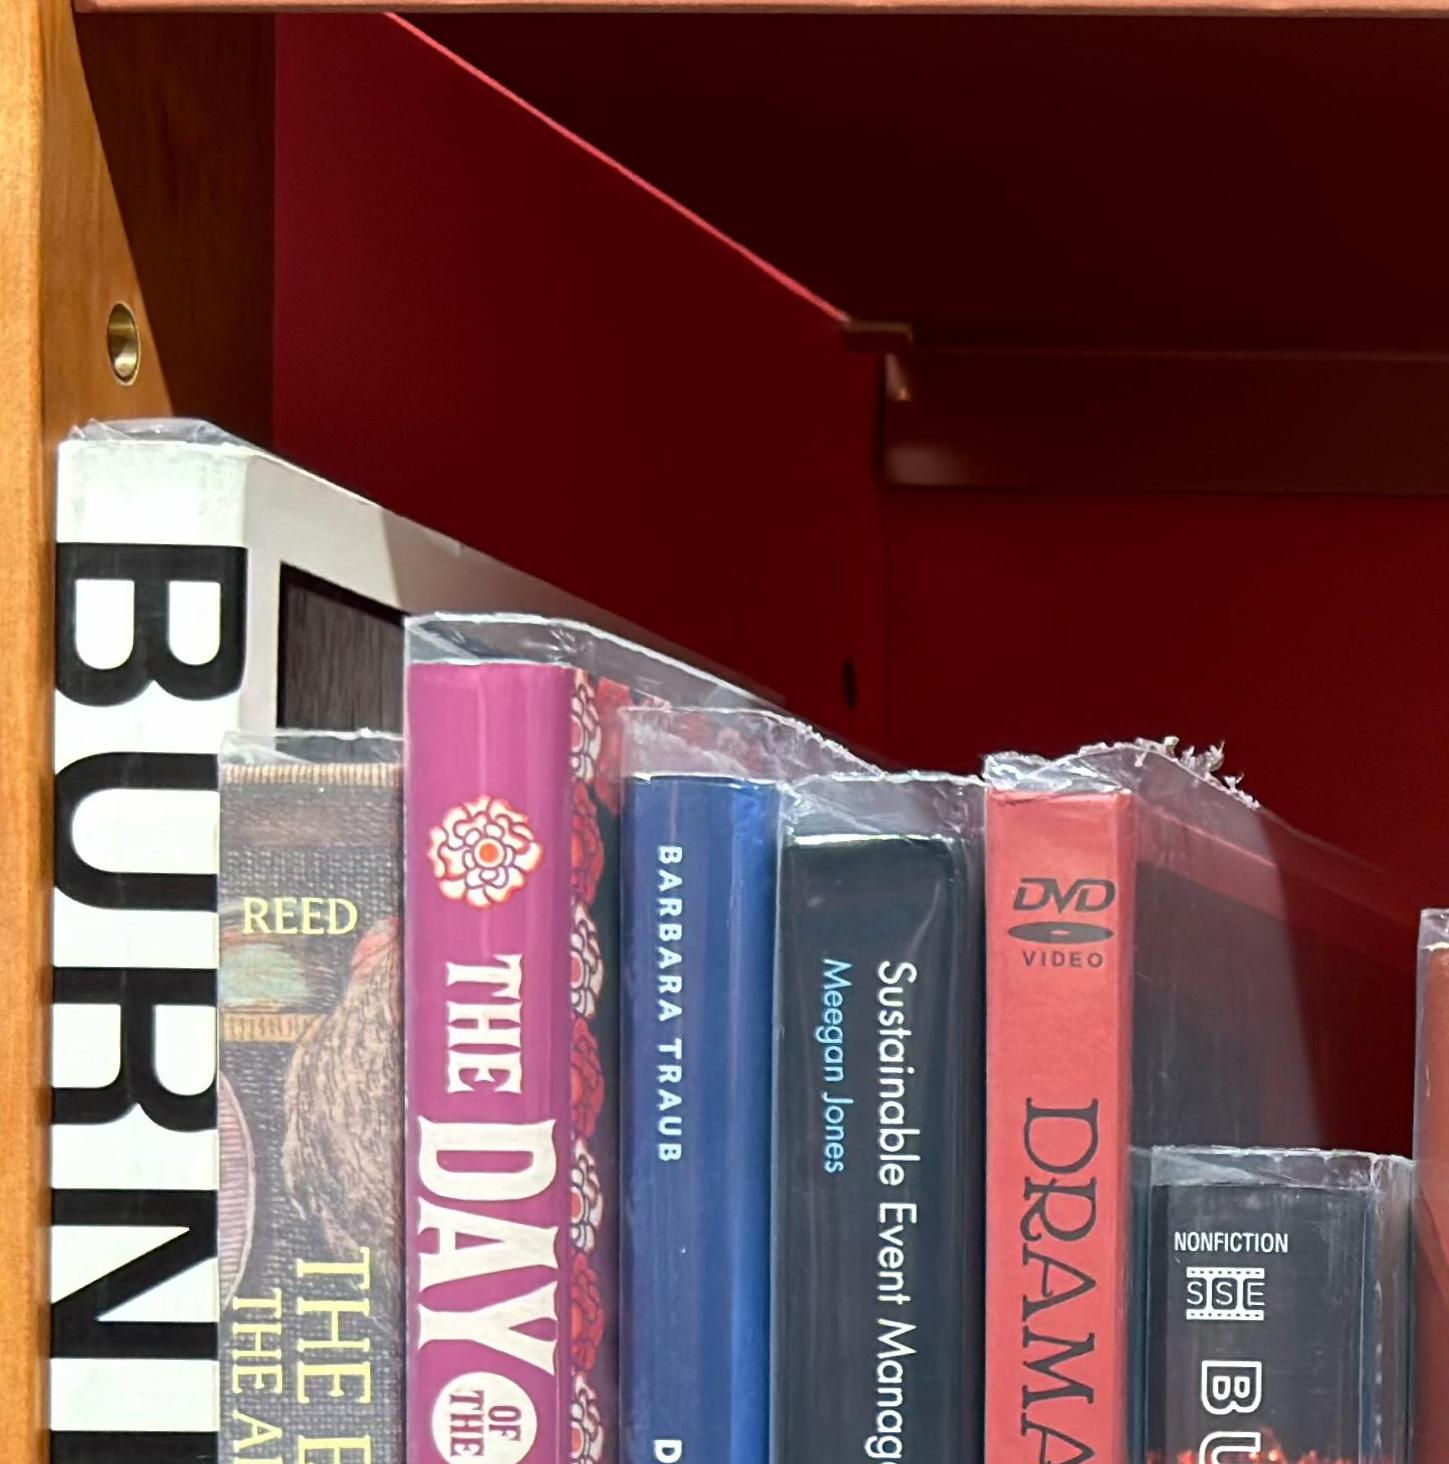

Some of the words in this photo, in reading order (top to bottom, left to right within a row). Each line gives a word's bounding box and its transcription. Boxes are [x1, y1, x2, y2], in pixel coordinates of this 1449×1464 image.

[242, 897, 358, 934] REED
[657, 846, 683, 1022] BARBARA
[1013, 878, 1116, 914] DVD
[1022, 950, 1104, 968] VIDEO
[447, 953, 522, 1094] THE
[814, 957, 852, 1083] Meegan
[656, 1038, 683, 1162] TRAUB
[876, 960, 921, 1187] Sustainable
[821, 1092, 853, 1174] Jones
[418, 1117, 558, 1375] DAY
[878, 1203, 917, 1305] Event
[1174, 1231, 1289, 1254] NONFICTION
[232, 1290, 282, 1395] THE
[297, 1247, 371, 1404] THE
[450, 1390, 485, 1458] THE
[486, 1405, 521, 1443] OF
